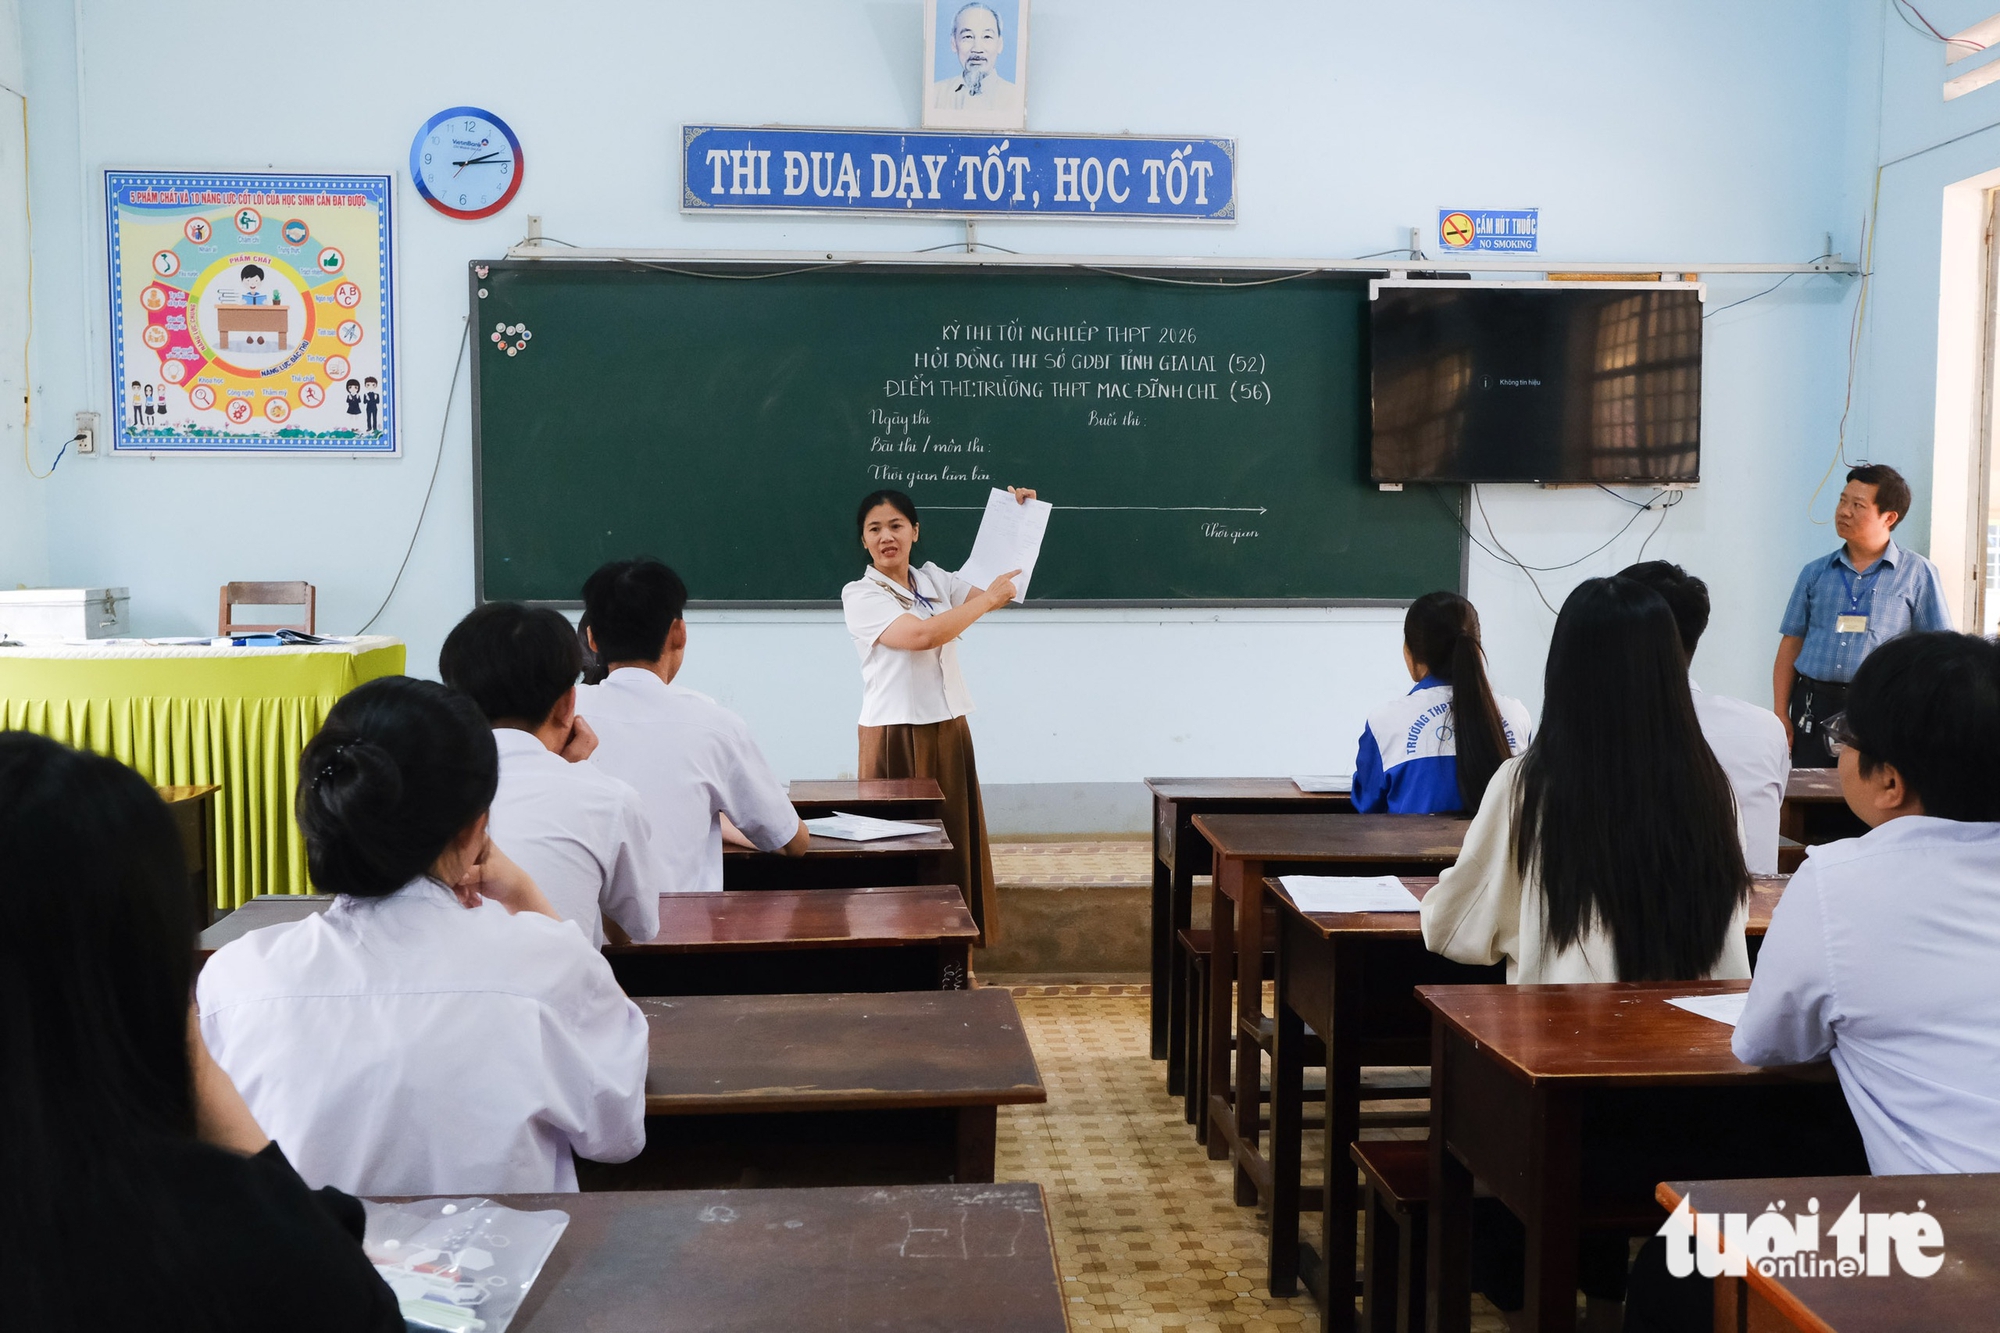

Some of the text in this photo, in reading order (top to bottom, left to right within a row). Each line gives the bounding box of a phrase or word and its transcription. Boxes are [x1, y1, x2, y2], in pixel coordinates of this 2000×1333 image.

[446, 124, 454, 133] 11
[464, 121, 476, 133] 12
[431, 136, 440, 145] 10
[452, 138, 481, 148] VietinBank
[500, 145, 506, 154] 2
[424, 153, 432, 165] 9
[500, 163, 508, 174] 3
[428, 174, 434, 183] 8
[705, 139, 1214, 212] THI ĐUA DẠY TỐT, HỌC TỐT
[130, 191, 135, 203] 5
[160, 188, 178, 203] CHẤT
[180, 190, 189, 204] VÀ
[191, 193, 199, 204] 10
[282, 194, 295, 208] HỌC
[298, 195, 314, 206] SINH
[459, 193, 467, 205] 6
[1476, 213, 1536, 235] CẤM HÚT THUỐC
[1479, 240, 1532, 249] NO SMOKING
[339, 287, 356, 296] A B
[344, 296, 351, 305] C
[942, 318, 1197, 344] KỲ THI TỐT NGHIỆP THPT 2026
[955, 346, 1005, 369] ĐỒNG
[1010, 353, 1038, 369] THI
[1119, 349, 1153, 371] TỈNH
[1228, 353, 1266, 375] (52)
[883, 373, 934, 398] ĐIỂM
[1050, 381, 1091, 398] THPT
[1187, 383, 1219, 400] CHI
[1230, 380, 1271, 405] (56)
[897, 437, 917, 453] thi
[932, 438, 962, 453] môn
[906, 470, 938, 488] gian
[1230, 528, 1259, 544] gian
[1406, 713, 1431, 755] TRƯỜNG
